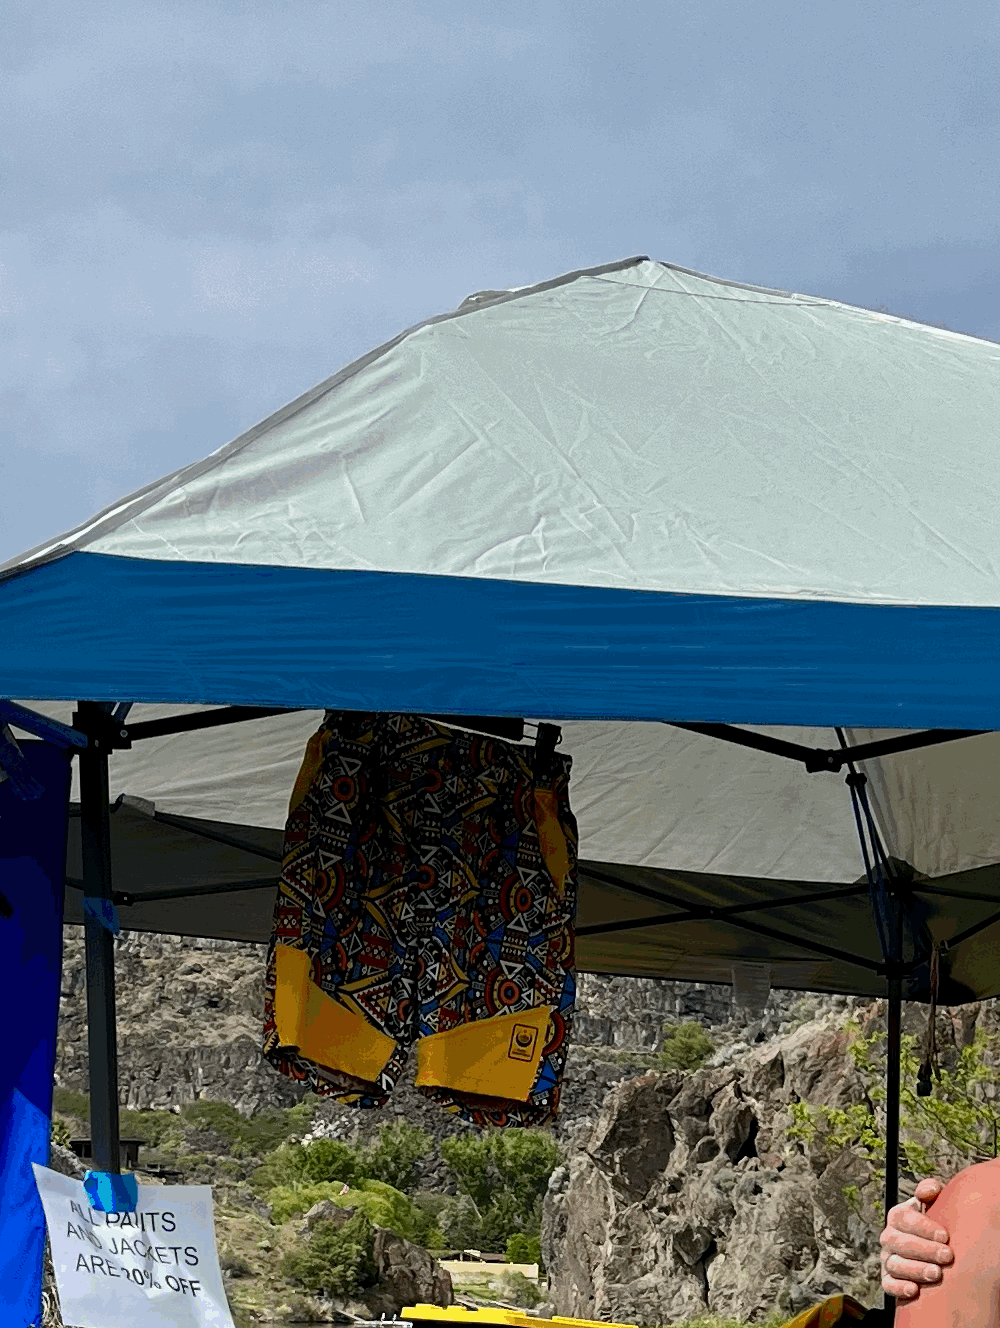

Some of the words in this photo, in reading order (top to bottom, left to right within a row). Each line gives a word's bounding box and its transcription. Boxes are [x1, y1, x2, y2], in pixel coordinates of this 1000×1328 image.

[69, 1200, 101, 1228] ALL
[66, 1220, 103, 1250] AND
[108, 1237, 199, 1266] JACKETS
[75, 1252, 121, 1278] ARE
[120, 1267, 162, 1290] 20%
[165, 1274, 202, 1298] OFF
